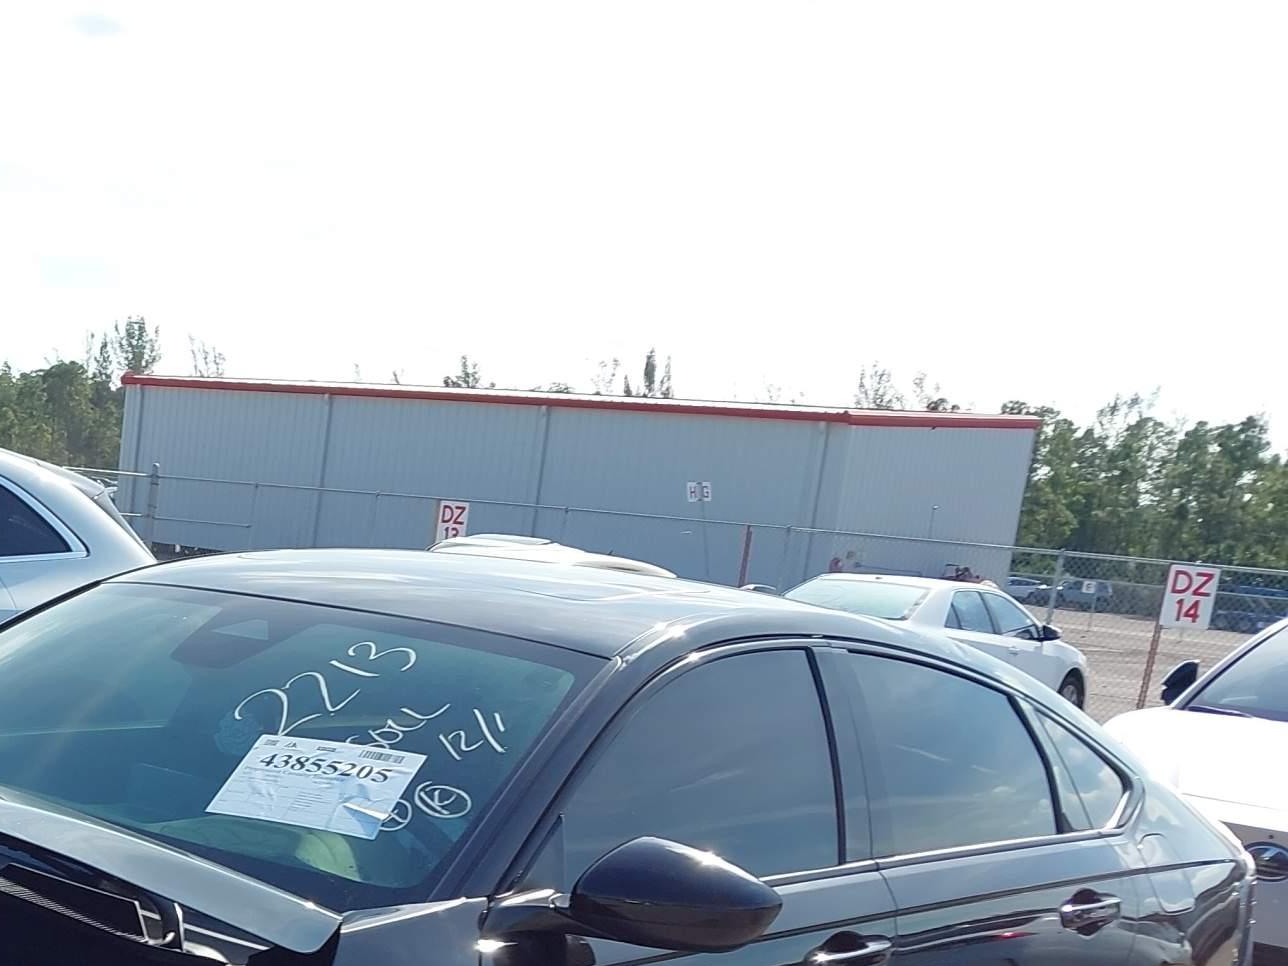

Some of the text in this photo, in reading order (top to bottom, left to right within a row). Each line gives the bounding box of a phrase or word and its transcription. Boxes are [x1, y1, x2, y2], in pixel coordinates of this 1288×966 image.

[441, 504, 466, 525] DZ
[1170, 569, 1216, 598] DZ
[1174, 598, 1201, 624] 14
[234, 640, 417, 736] 2213
[259, 752, 394, 783] 43855205
